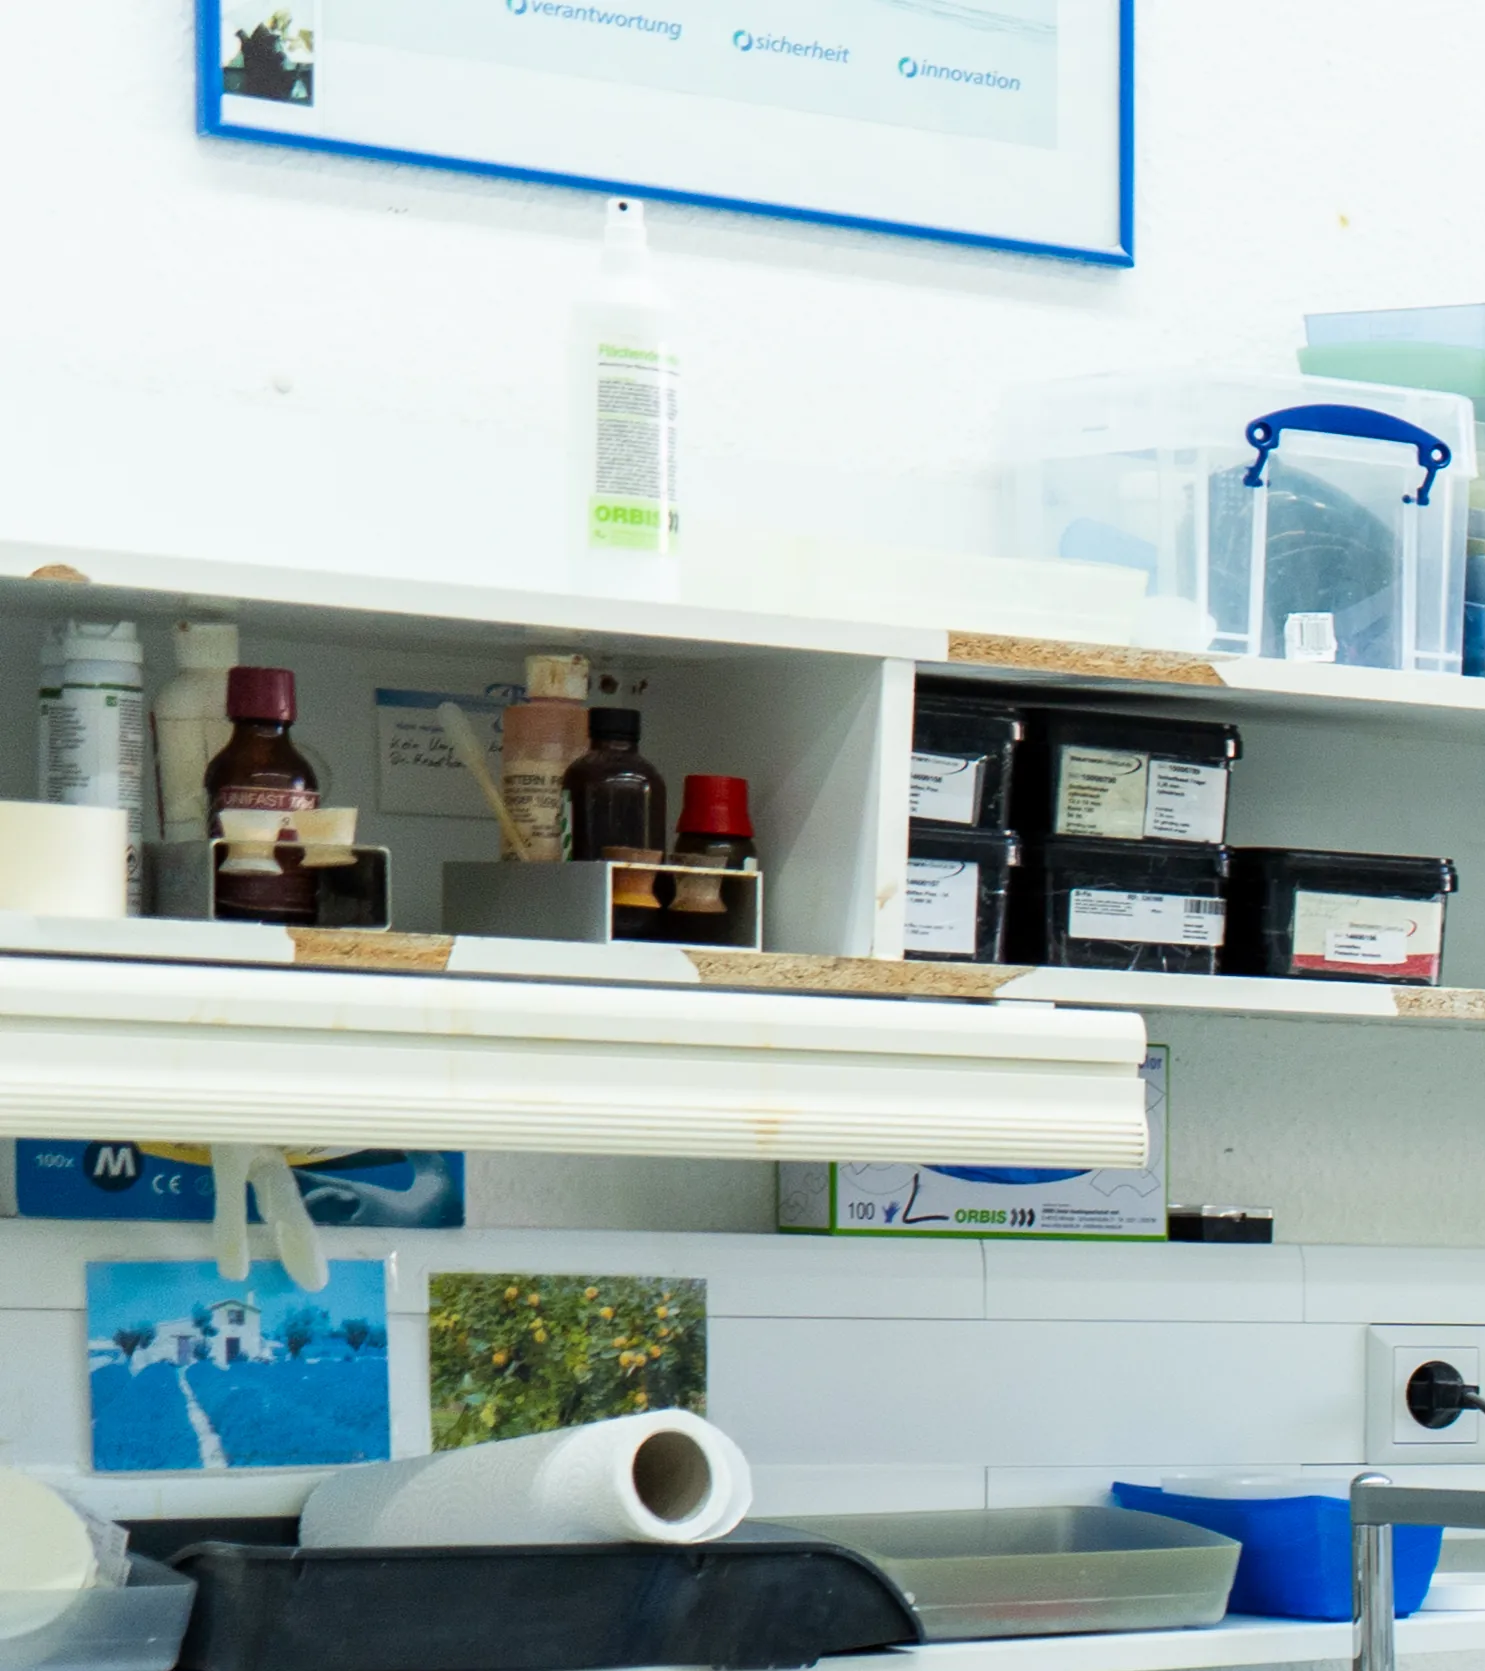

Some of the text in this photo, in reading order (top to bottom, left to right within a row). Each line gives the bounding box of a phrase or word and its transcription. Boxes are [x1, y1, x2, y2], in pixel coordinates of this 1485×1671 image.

[531, 0, 682, 40] verantwortung
[756, 33, 850, 63] sicherheit
[920, 59, 1022, 91] innovation
[223, 792, 286, 807] UNIFAST
[36, 1153, 75, 1168] 100x
[93, 1147, 137, 1178] M
[848, 1202, 875, 1220] 100
[955, 1209, 1007, 1224] ORBIS
